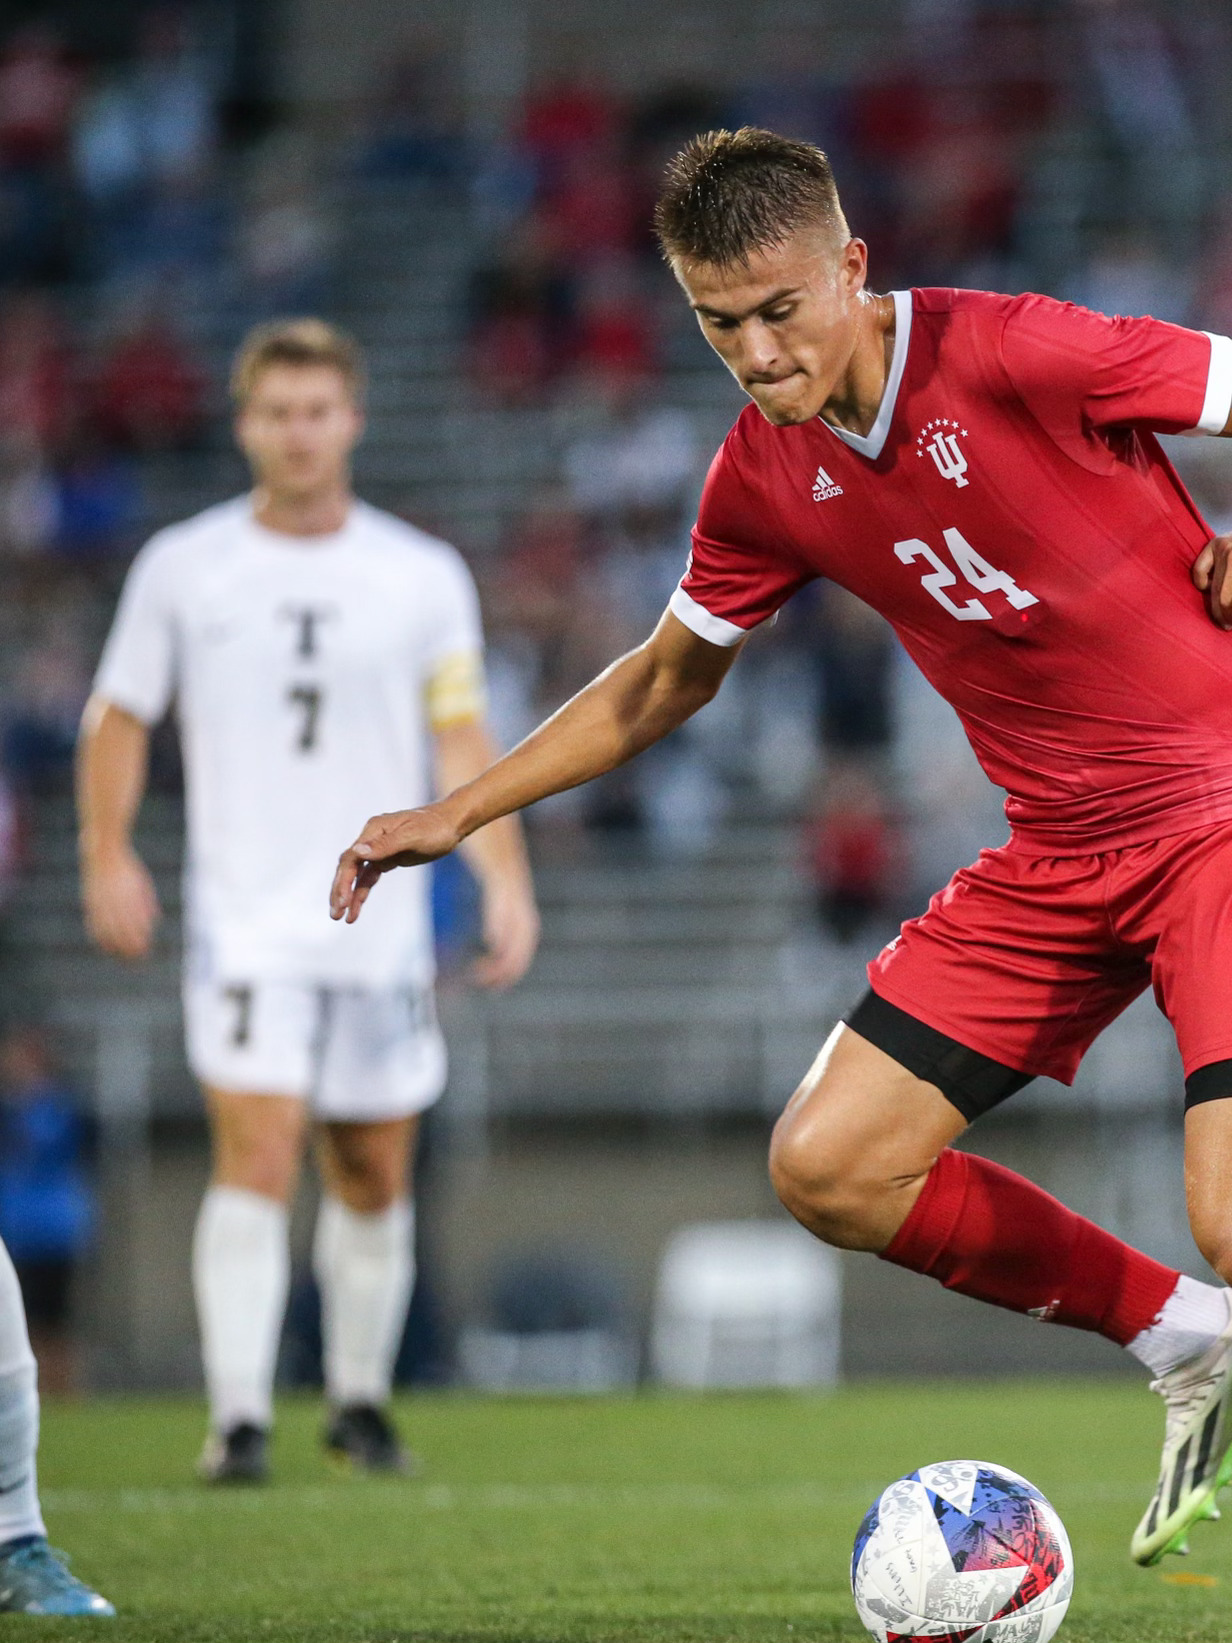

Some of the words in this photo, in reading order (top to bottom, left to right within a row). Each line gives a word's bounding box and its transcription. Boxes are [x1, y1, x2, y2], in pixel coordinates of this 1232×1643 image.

[813, 486, 844, 502] adidas
[894, 527, 1039, 621] 24
[288, 682, 326, 757] 7
[223, 983, 253, 1048] 7
